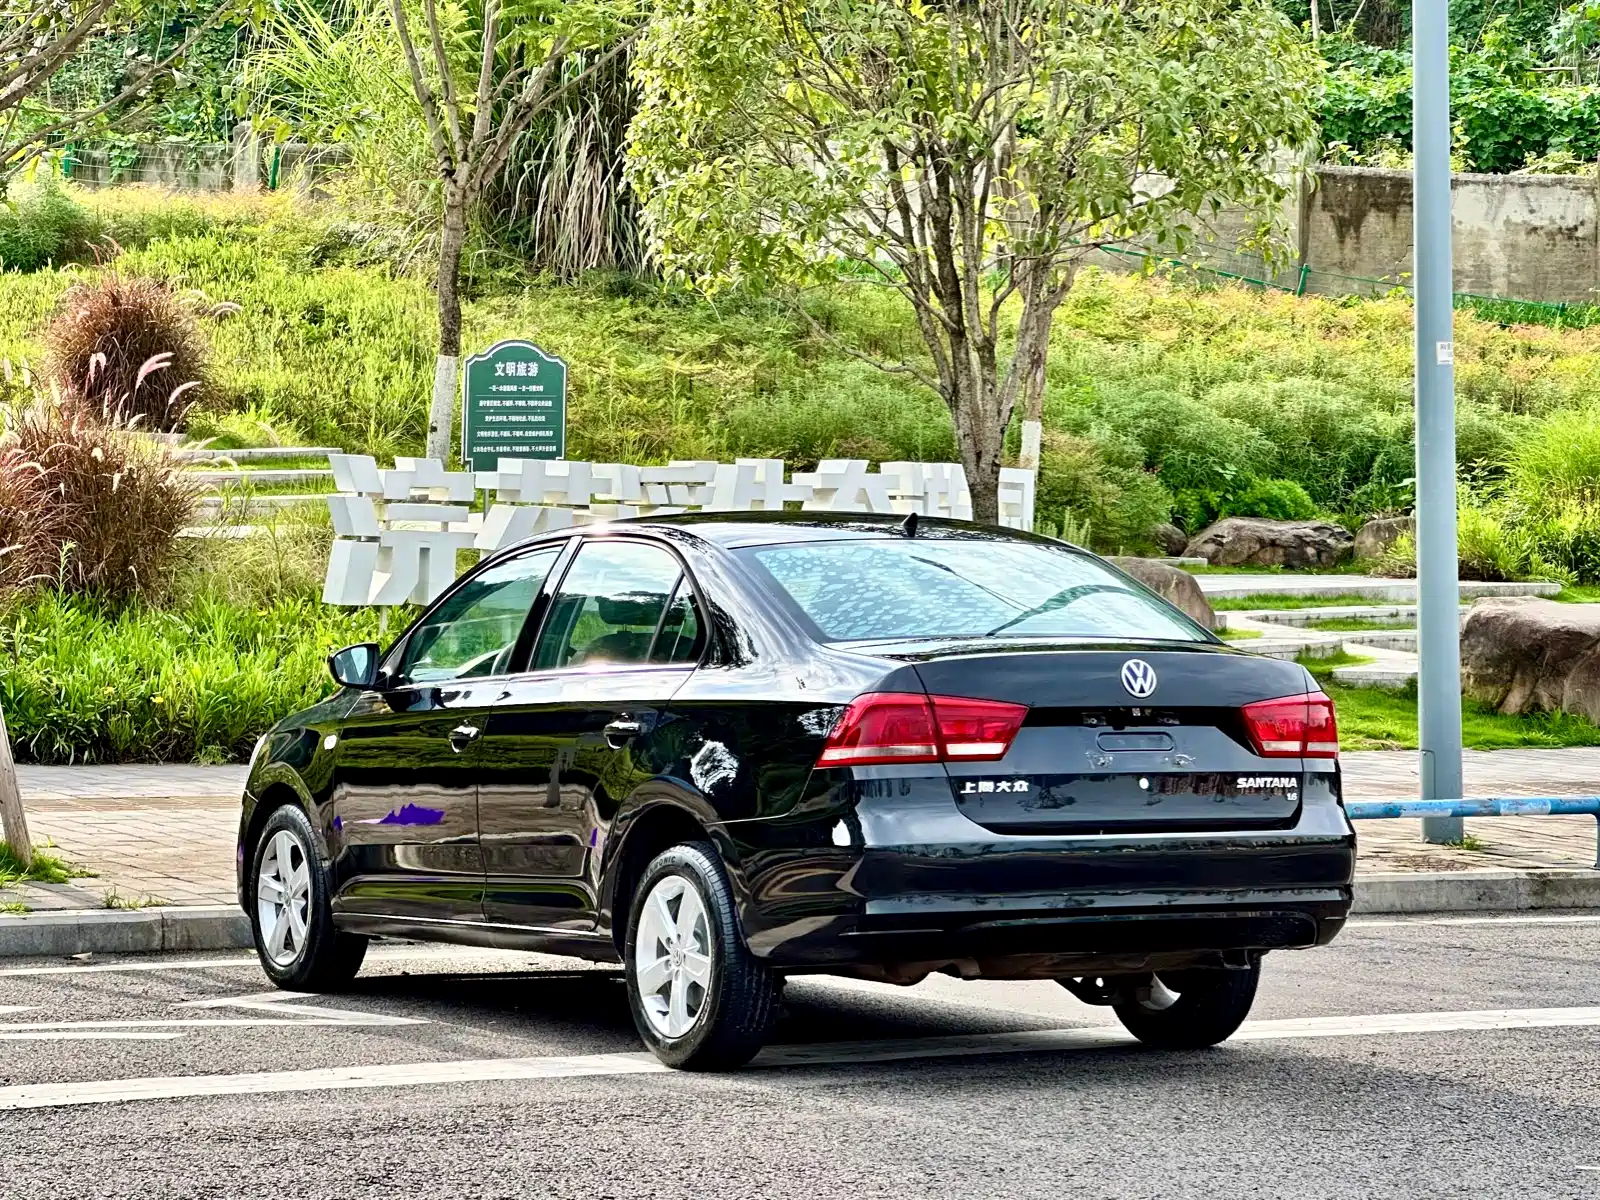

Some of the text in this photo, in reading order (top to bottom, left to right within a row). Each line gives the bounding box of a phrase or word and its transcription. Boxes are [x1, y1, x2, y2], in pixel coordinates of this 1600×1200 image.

[494, 361, 539, 377] 文明旅游
[1121, 658, 1157, 698] VW
[1236, 777, 1298, 788] SANTANA
